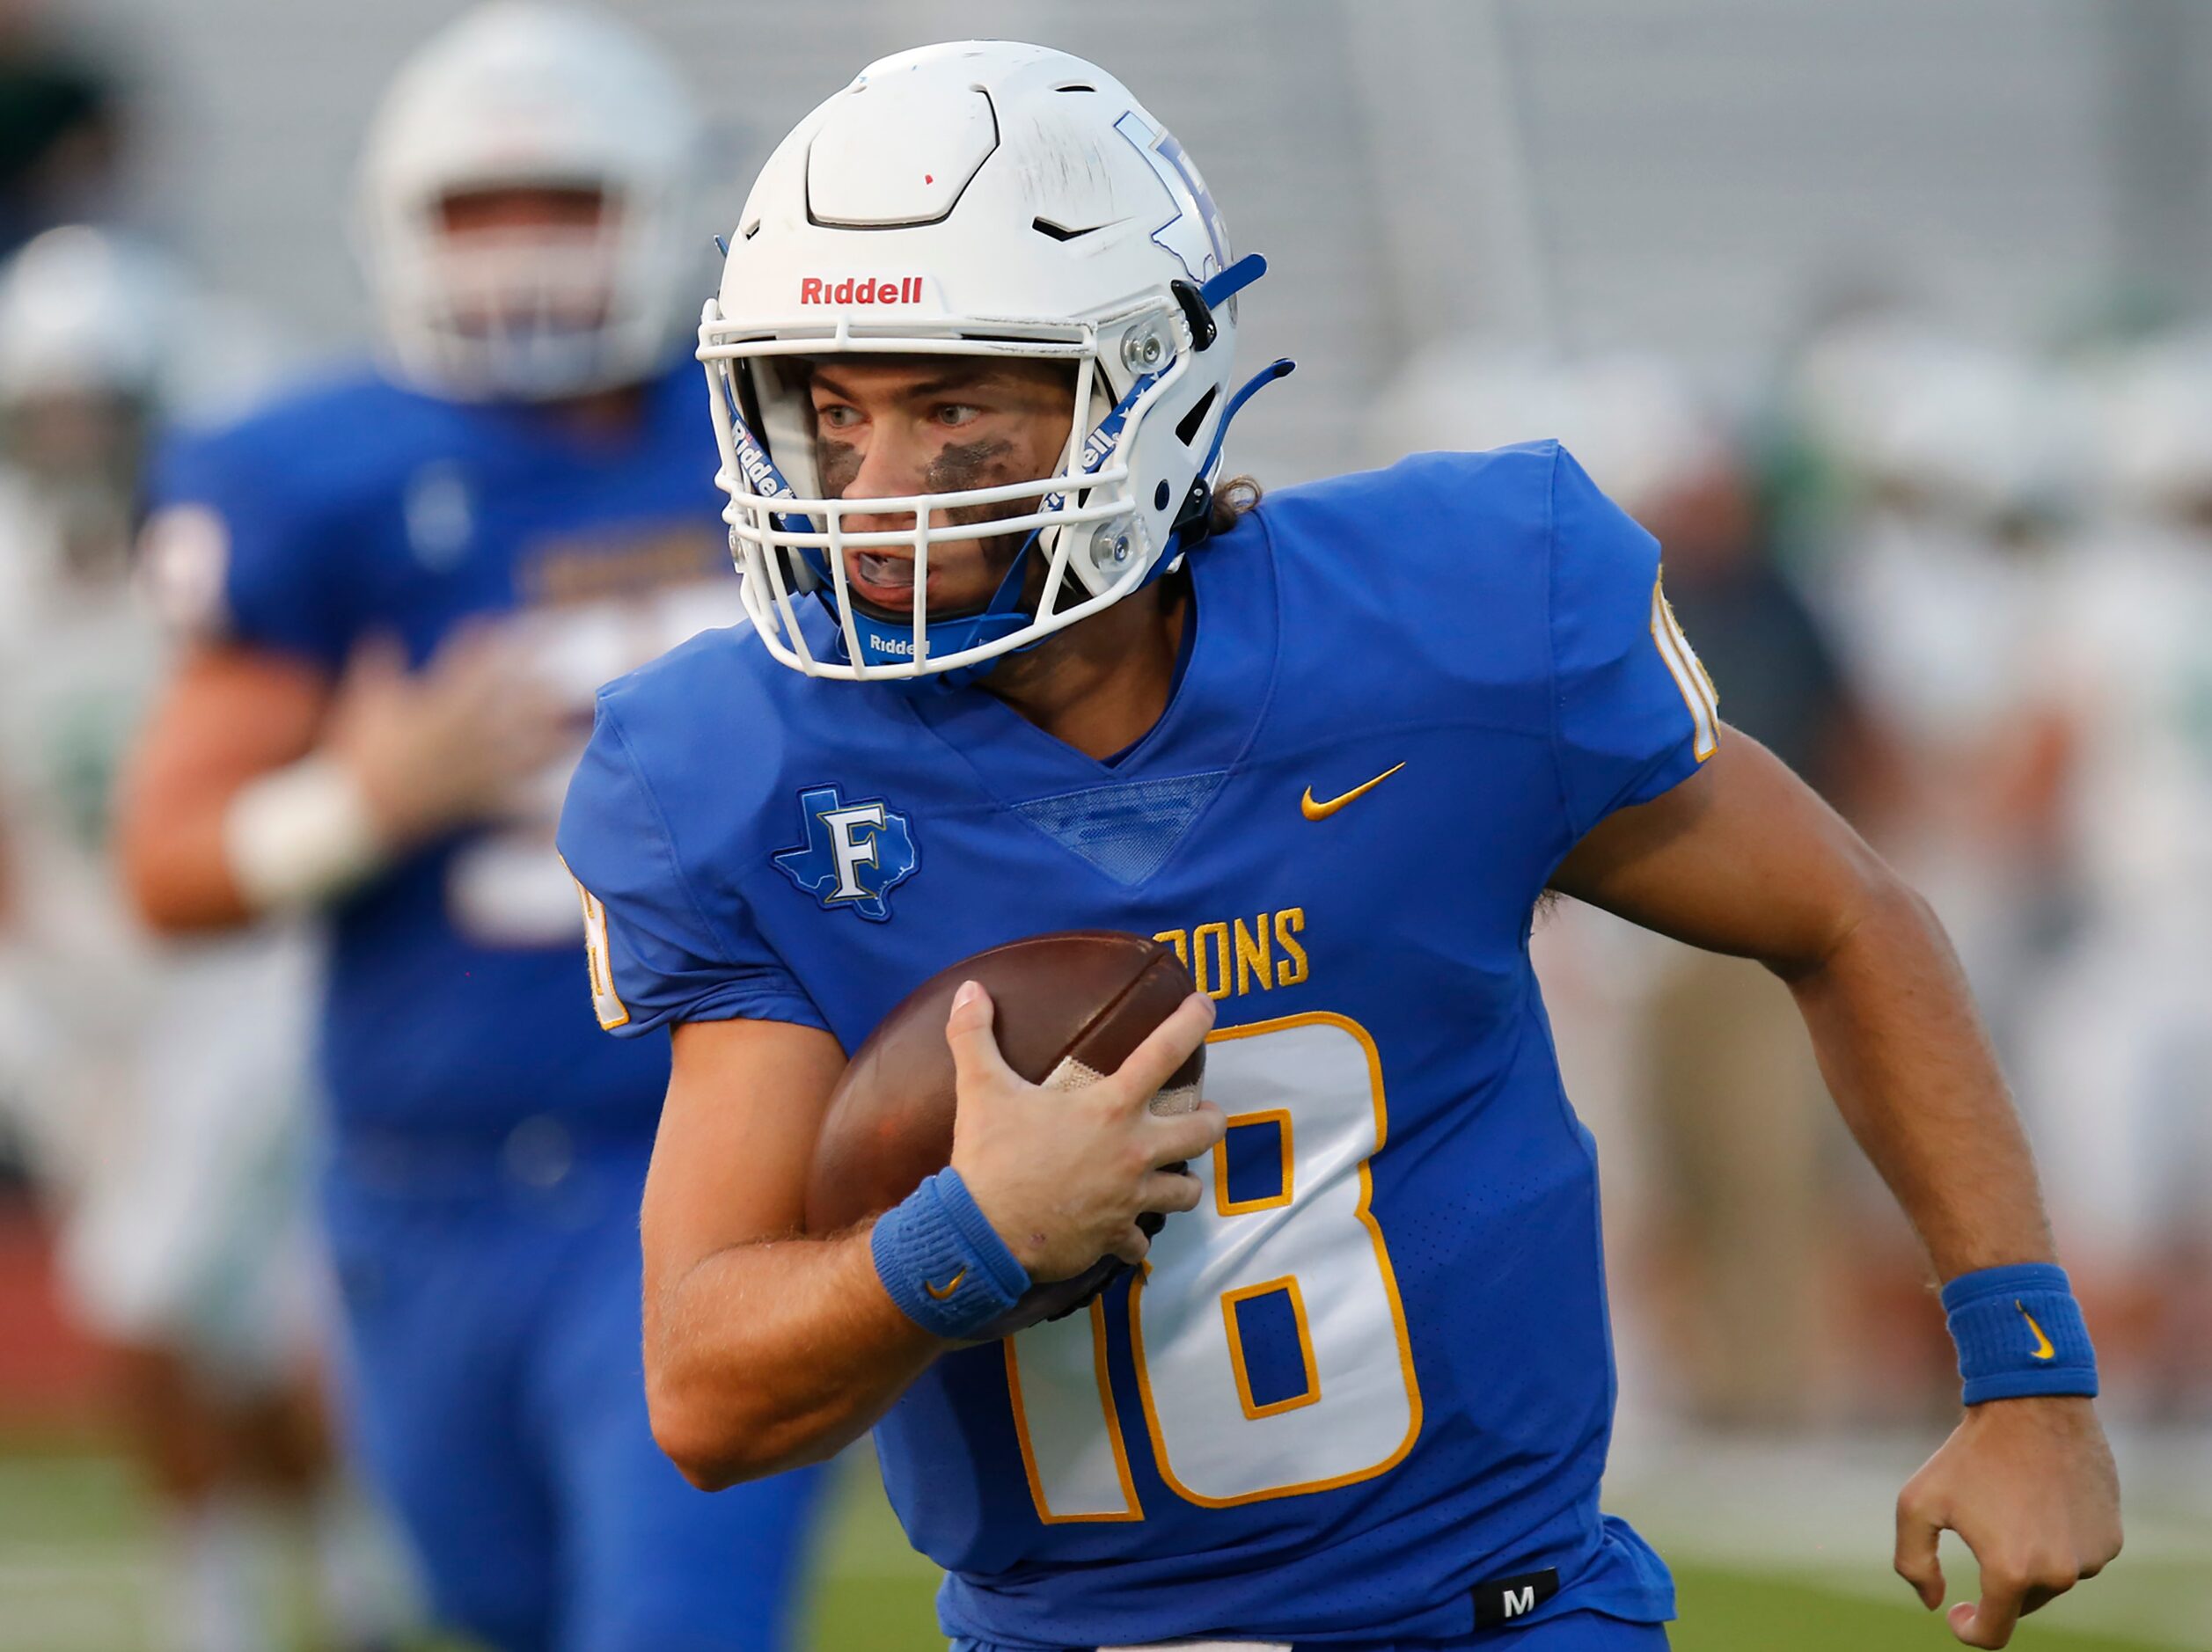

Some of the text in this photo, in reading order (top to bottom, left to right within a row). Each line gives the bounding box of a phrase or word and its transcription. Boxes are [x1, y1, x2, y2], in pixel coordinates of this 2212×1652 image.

[801, 277, 923, 304] Riddell
[869, 633, 931, 655] Riddel
[817, 803, 887, 903] F
[1503, 1585, 1535, 1619] M
